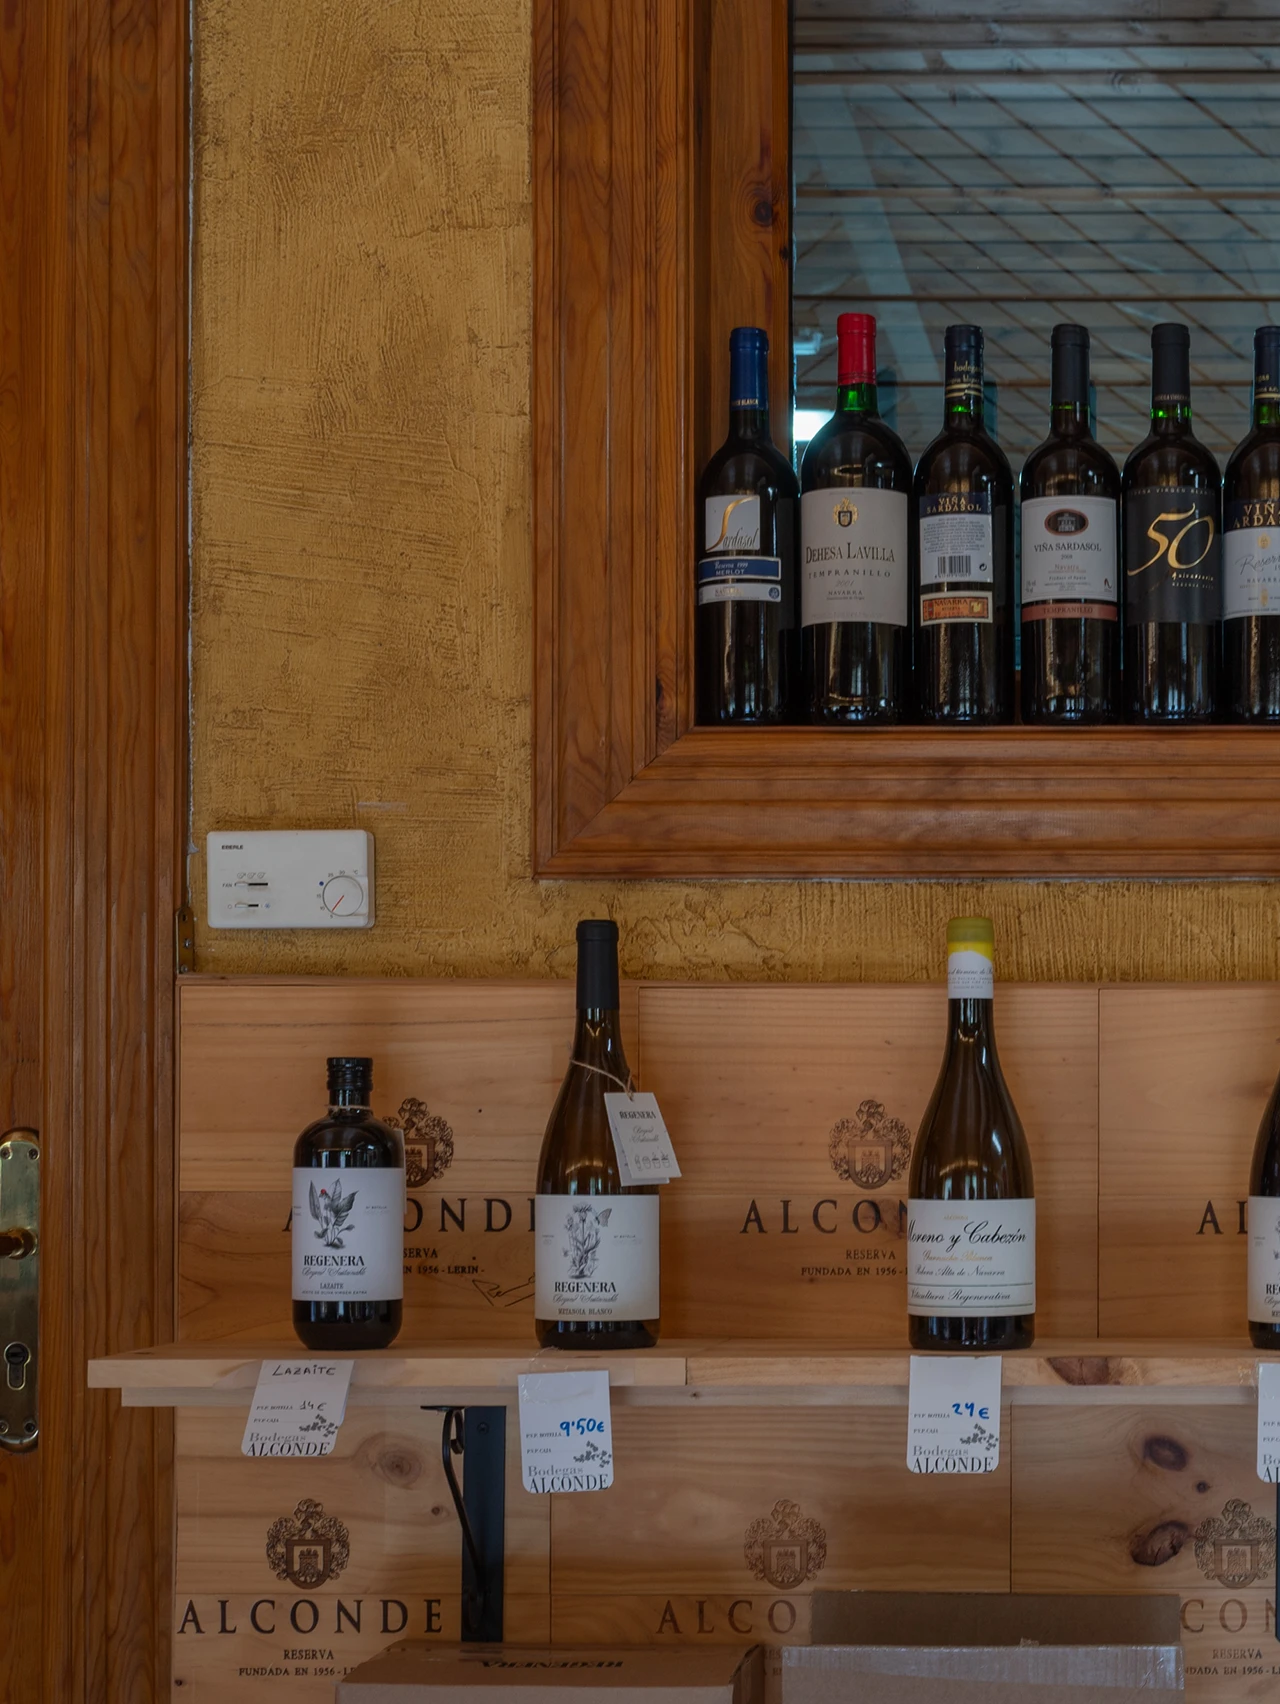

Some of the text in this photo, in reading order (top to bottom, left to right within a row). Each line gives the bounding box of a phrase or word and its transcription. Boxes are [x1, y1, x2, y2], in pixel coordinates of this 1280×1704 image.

[926, 504, 982, 514] SARDASOL
[1127, 502, 1214, 576] 50
[806, 542, 895, 564] DEHESA LAVILLA
[1034, 542, 1102, 553] VIÑA SARDASOL
[809, 569, 891, 579] TEMPRANILLO
[619, 1110, 656, 1119] REGENERA
[963, 1220, 1026, 1244] Cabezón
[403, 1248, 438, 1258] SERVA
[846, 1249, 896, 1260] RESERVA
[304, 1255, 365, 1267] REGENERA
[417, 1265, 479, 1274] 1956 LERIN
[801, 1267, 897, 1276] FUNDADA EN 1956
[967, 1264, 1005, 1277] Navarra
[554, 1282, 617, 1293] REGENERA
[947, 1288, 1011, 1306] Regenerativa
[249, 1432, 307, 1443] Bodegas
[246, 1442, 331, 1457] ALCONDE
[913, 1445, 969, 1457] Bodegas
[528, 1464, 584, 1478] Bodegas
[912, 1458, 994, 1474] ALCONDE
[528, 1474, 609, 1494] ALCONDE
[177, 1598, 443, 1634] ALCONDE
[656, 1599, 797, 1635] ALCO
[283, 1649, 335, 1660] RESERVA
[1212, 1648, 1263, 1659] RESERVA
[238, 1667, 335, 1677] FUNDADA EN 1956
[1223, 1666, 1237, 1675] EN
[1242, 1666, 1264, 1675] 1956
